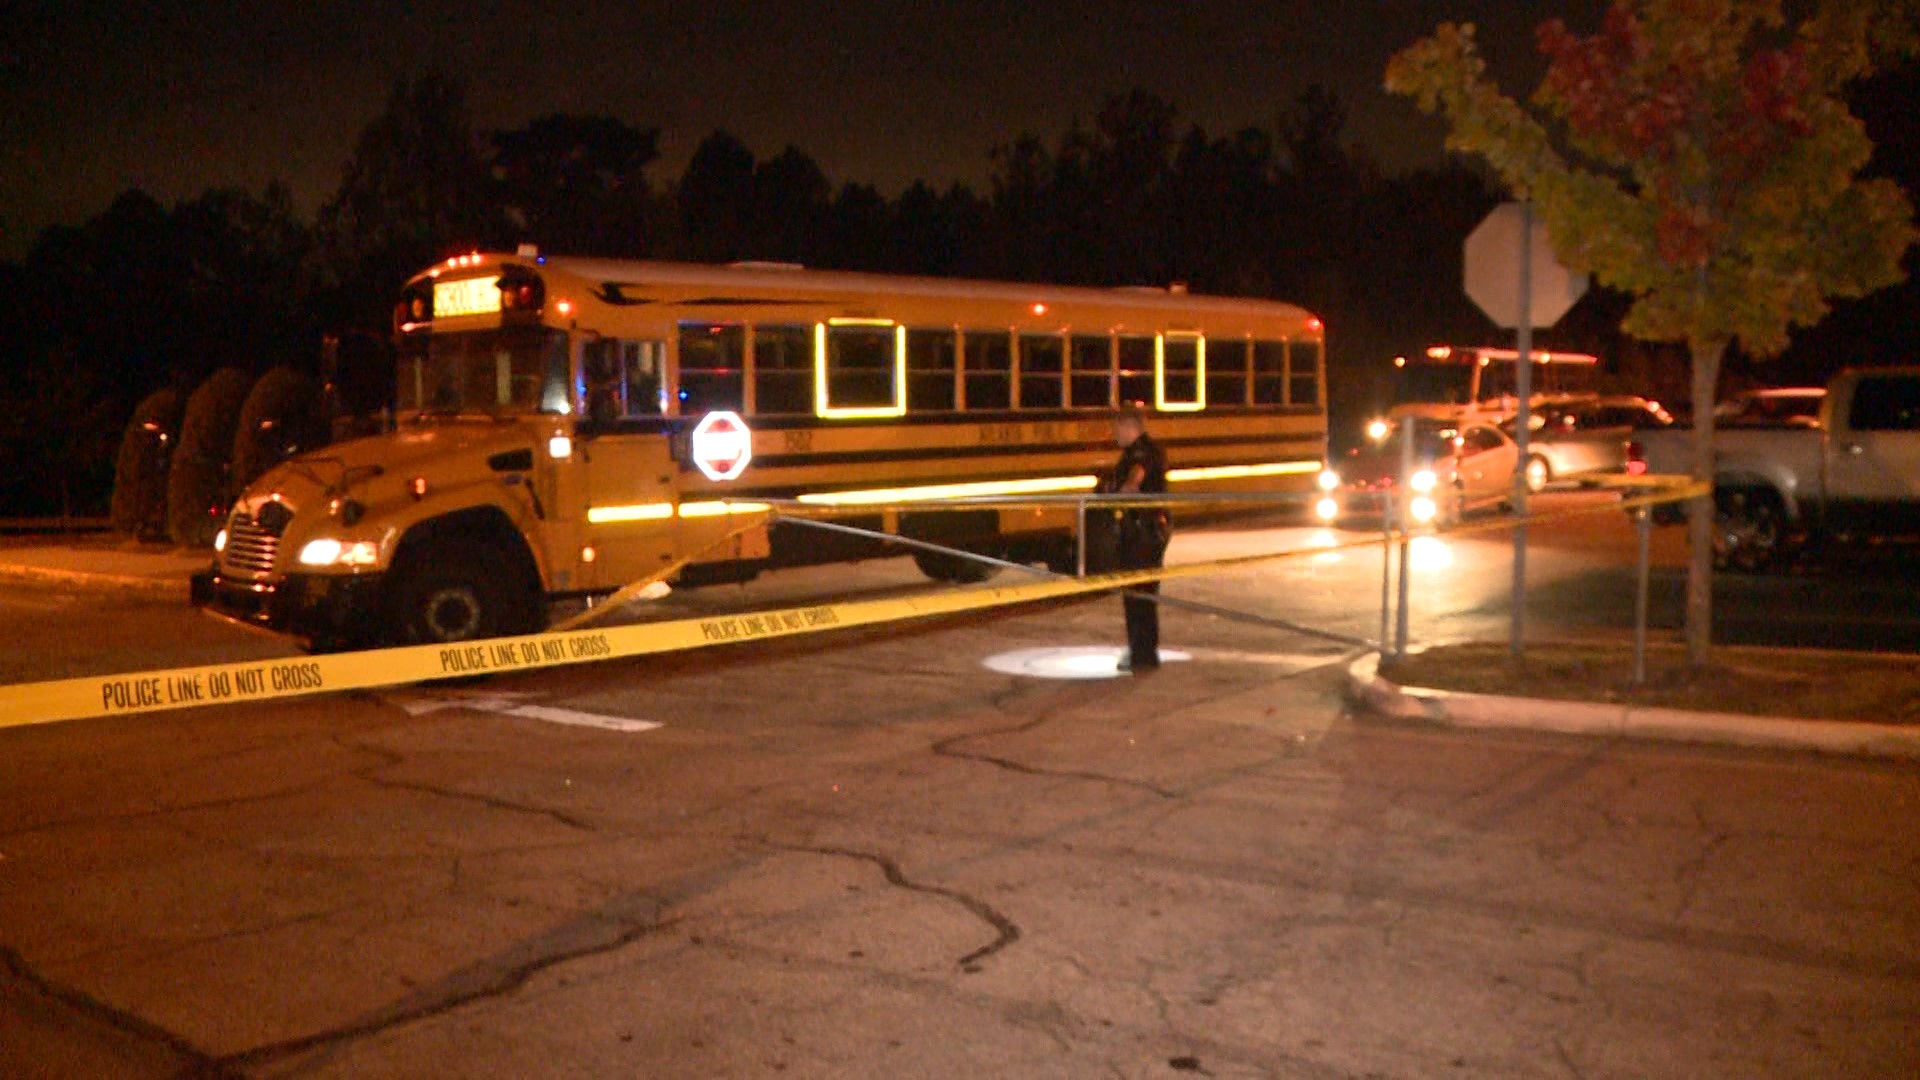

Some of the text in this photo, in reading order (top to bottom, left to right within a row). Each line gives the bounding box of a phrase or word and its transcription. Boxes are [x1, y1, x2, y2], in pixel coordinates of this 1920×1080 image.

[701, 620, 738, 640] POLICE
[740, 617, 766, 636] LINE
[440, 635, 611, 672] POLICE LINE DO NOT CROSS
[102, 663, 322, 711] POLICE LINE DO NOT CROSS
